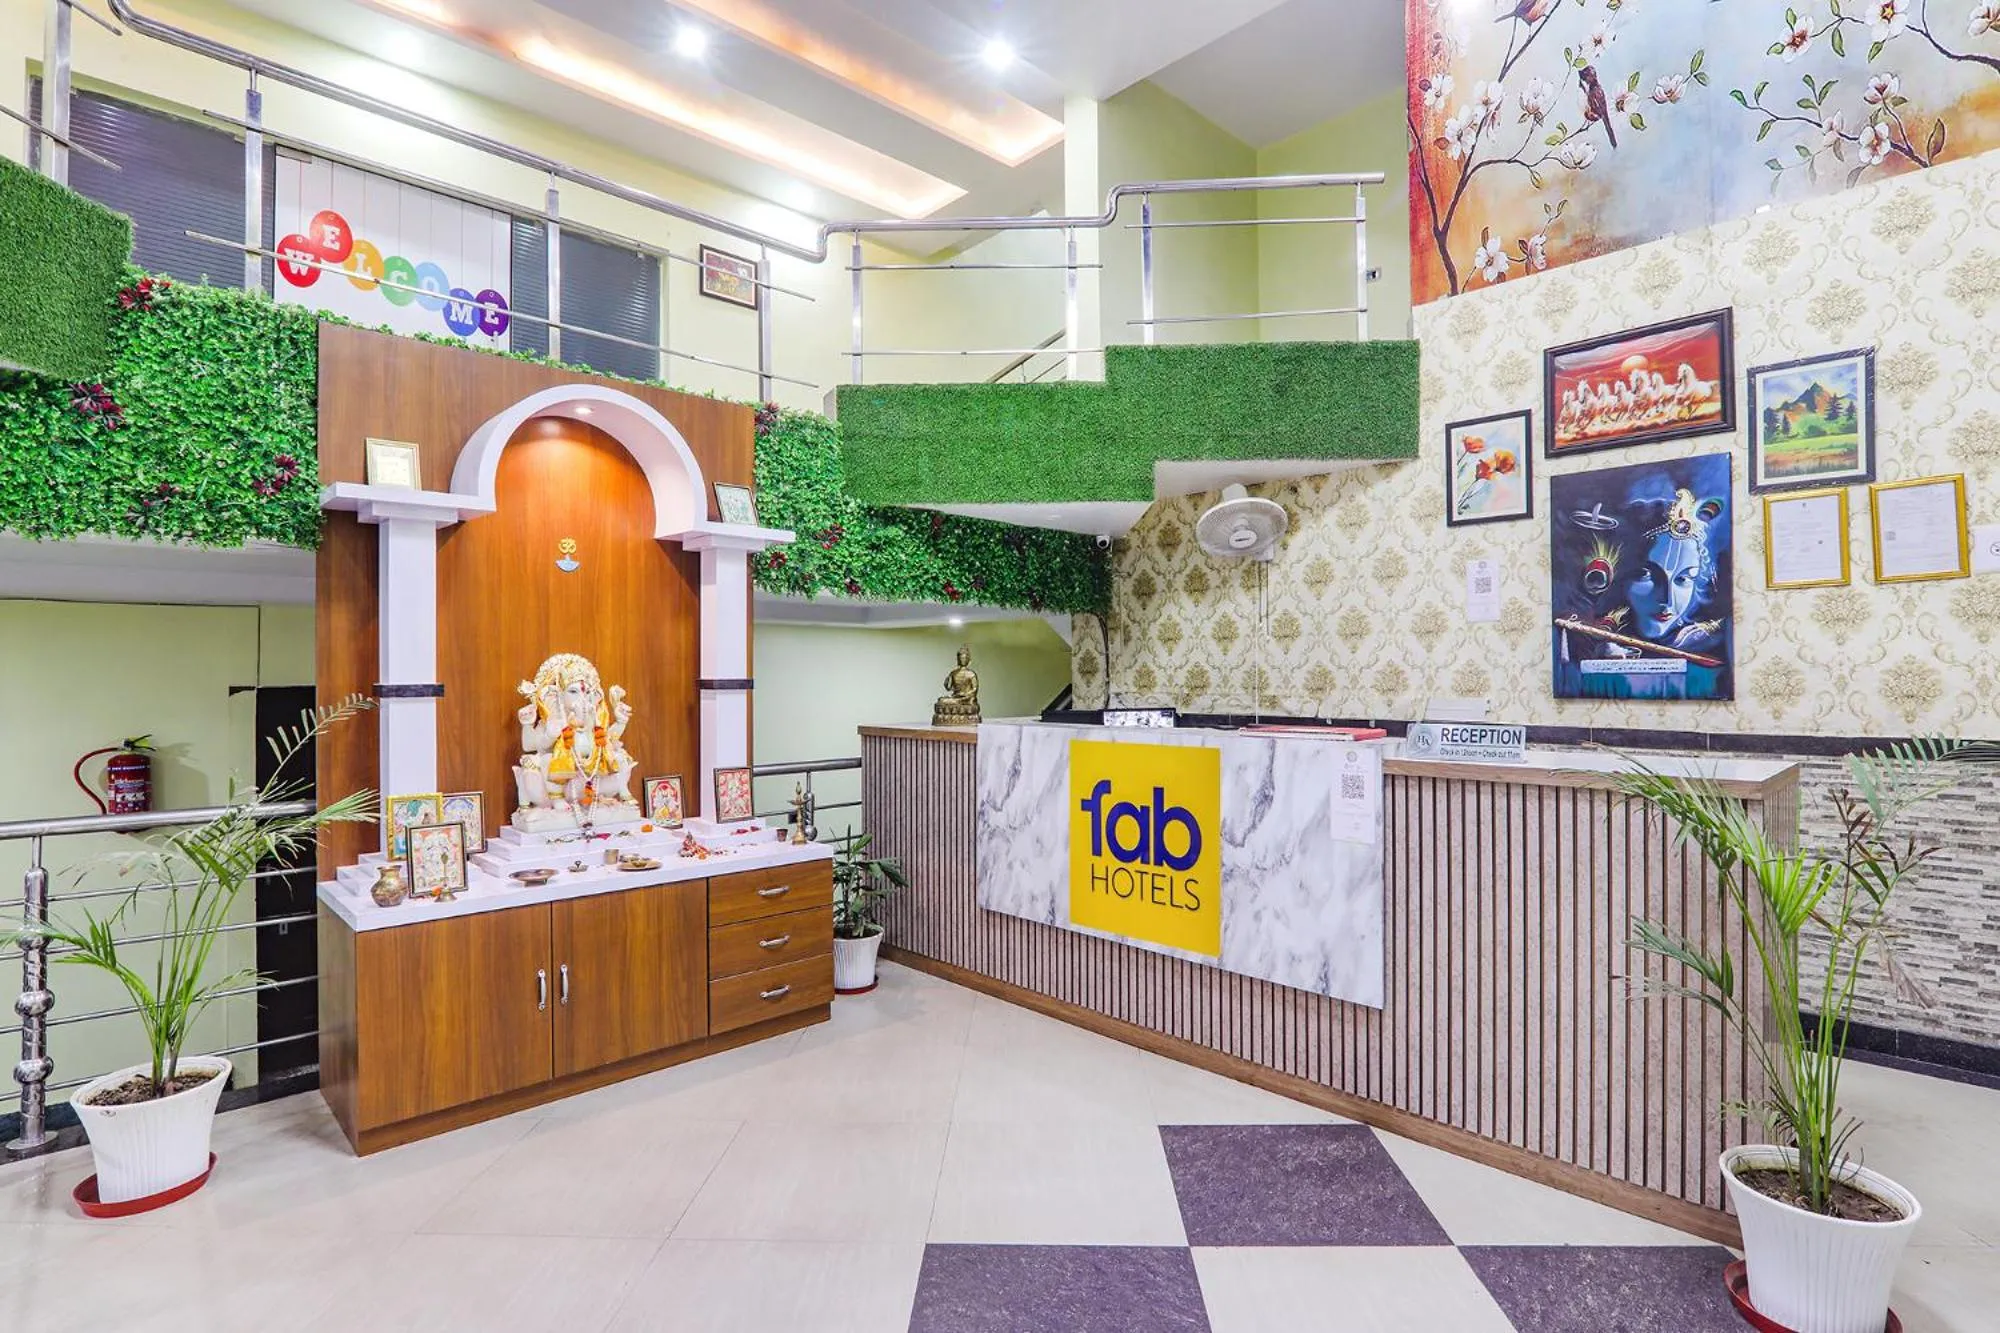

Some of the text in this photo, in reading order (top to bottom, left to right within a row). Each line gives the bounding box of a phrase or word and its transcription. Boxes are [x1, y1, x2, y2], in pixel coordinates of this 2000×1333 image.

[284, 224, 500, 325] WELCOME
[1440, 727, 1522, 745] RECEPTION
[1081, 779, 1202, 872] fab
[1092, 863, 1201, 911] HOTELS
